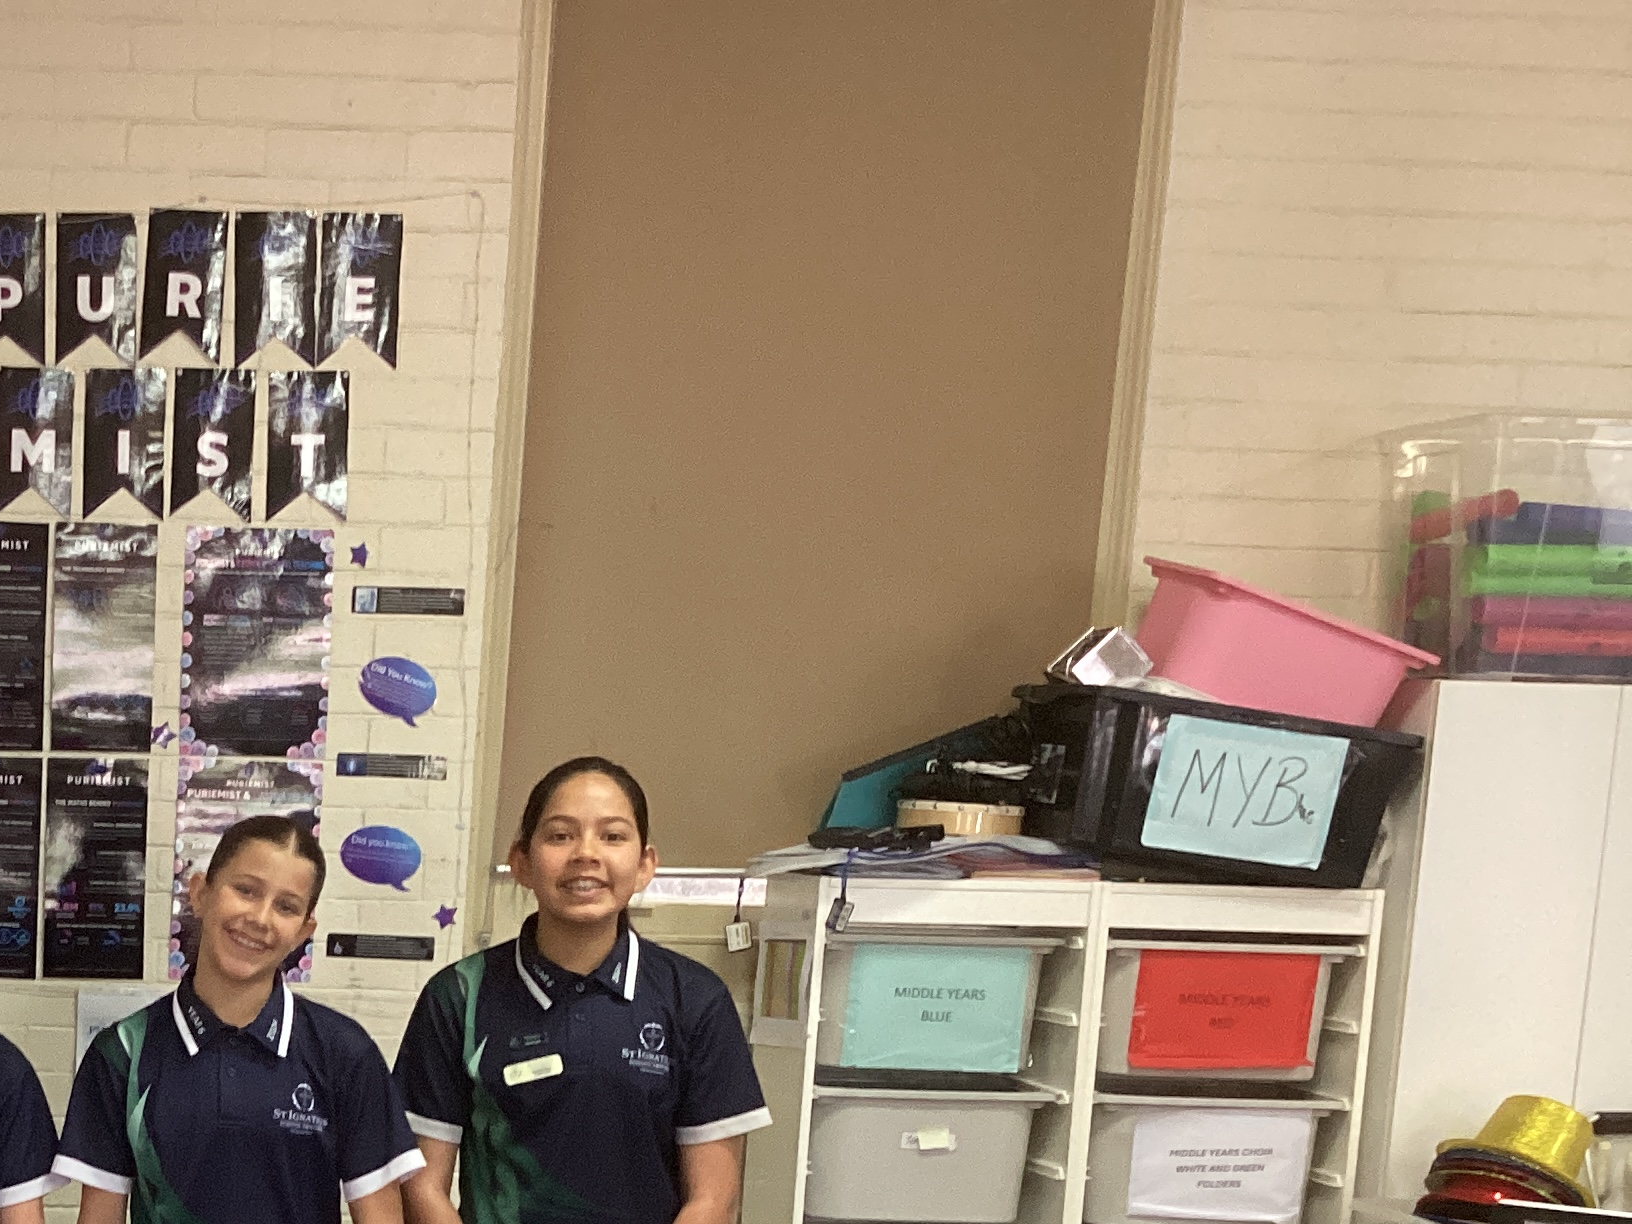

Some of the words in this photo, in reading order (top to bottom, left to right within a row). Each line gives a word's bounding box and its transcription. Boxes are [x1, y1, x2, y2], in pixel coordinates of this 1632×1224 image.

[894, 987, 944, 999] MIDDLE
[947, 988, 986, 1001] YEARS
[921, 1009, 952, 1022] BLUE
[1169, 1148, 1207, 1157] MIDDLE
[1209, 1148, 1240, 1157] YEARS
